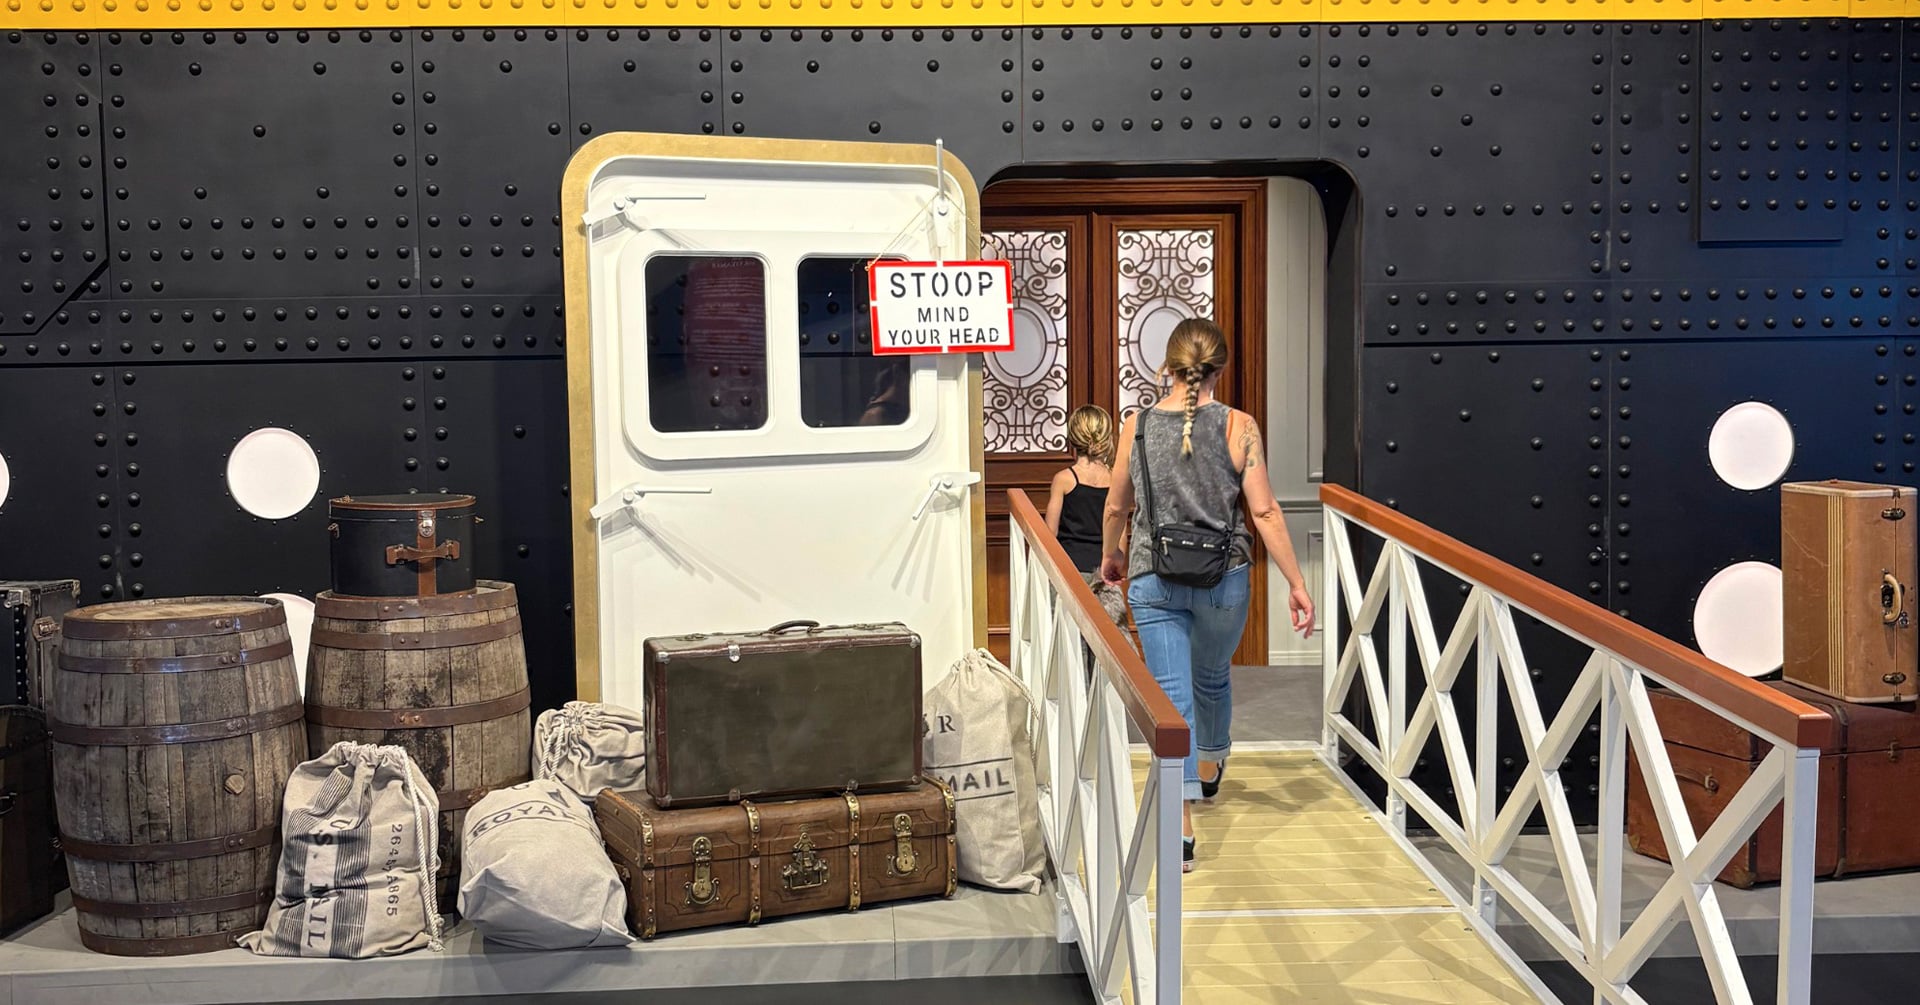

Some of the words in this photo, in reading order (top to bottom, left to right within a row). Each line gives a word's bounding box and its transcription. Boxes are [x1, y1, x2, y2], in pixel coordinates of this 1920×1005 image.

[890, 271, 993, 298] STOOP
[918, 306, 969, 323] MIND
[888, 329, 941, 346] YOUR
[950, 327, 999, 344] HEAD
[473, 805, 576, 837] ROYAL
